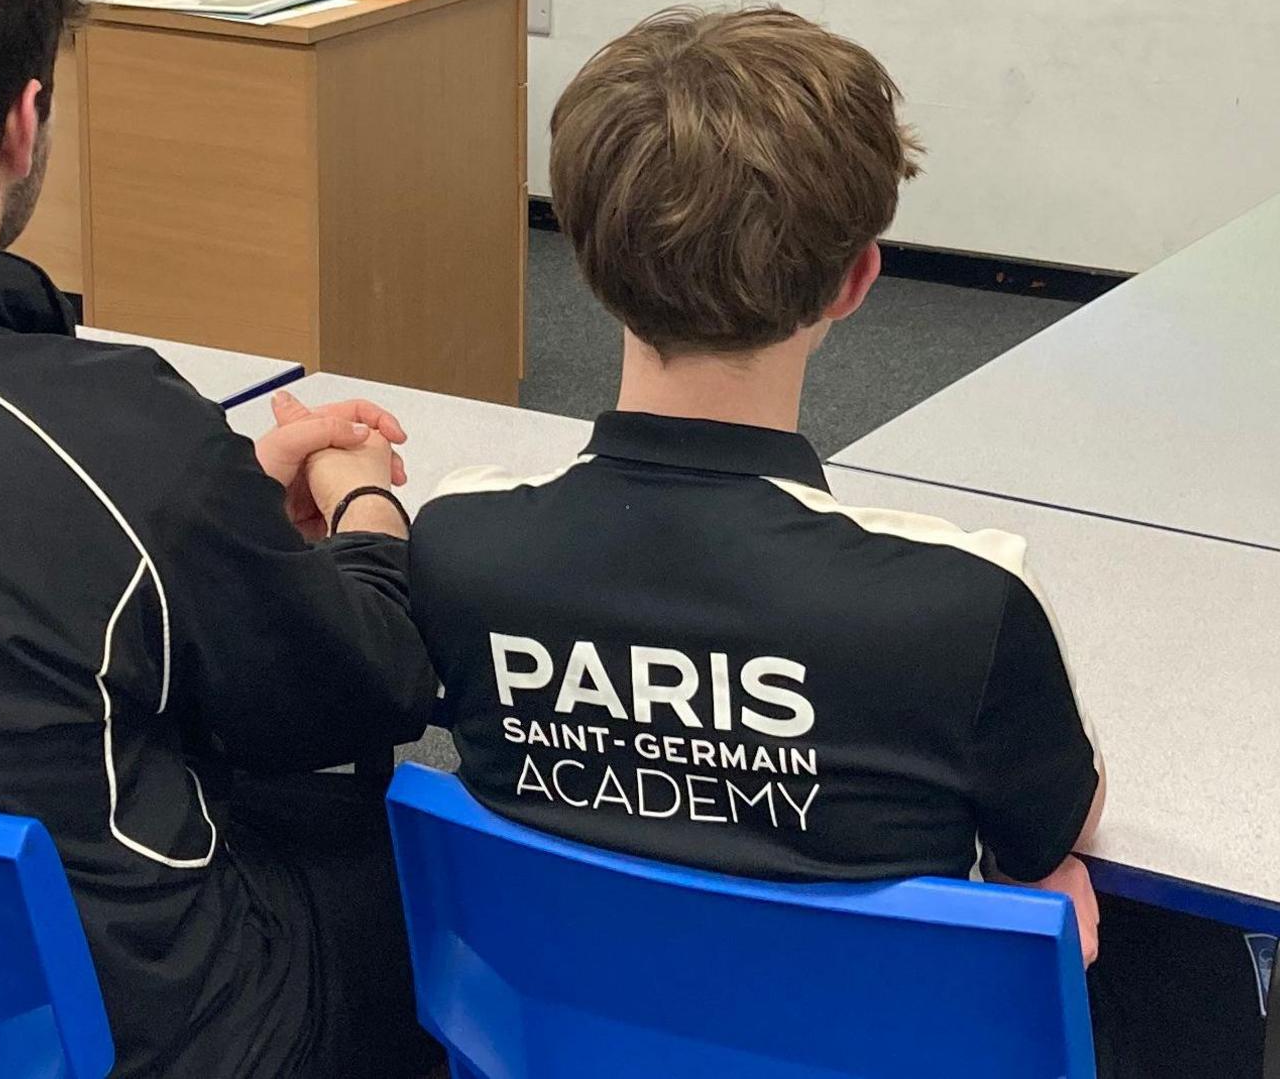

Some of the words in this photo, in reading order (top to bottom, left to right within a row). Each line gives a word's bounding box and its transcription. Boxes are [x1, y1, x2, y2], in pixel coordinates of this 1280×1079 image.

[489, 631, 816, 738] PARIS
[501, 716, 818, 776] SAINT-GERMAIN
[516, 753, 820, 832] ACADEMY
